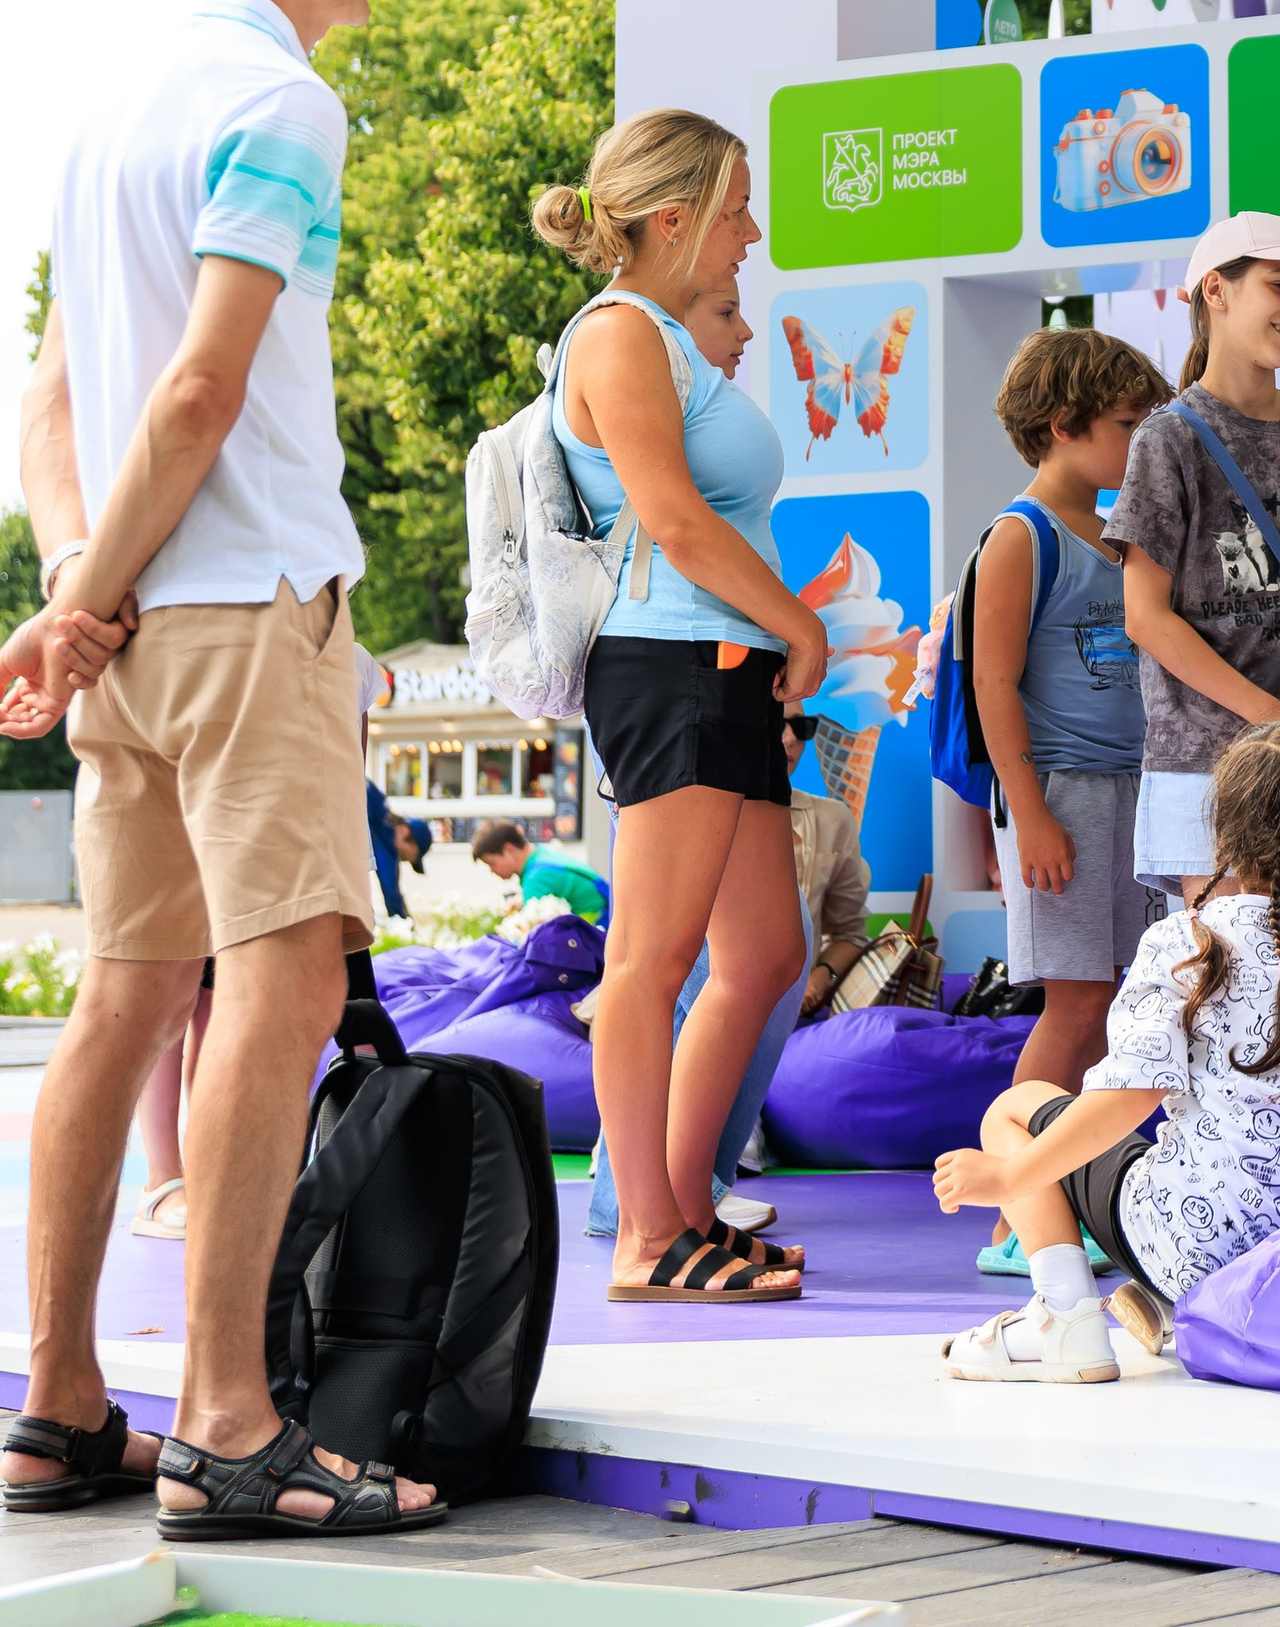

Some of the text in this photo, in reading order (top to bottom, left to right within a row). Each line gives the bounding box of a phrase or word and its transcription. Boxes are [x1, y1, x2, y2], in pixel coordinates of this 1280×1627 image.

[892, 128, 958, 150] ПРОЕКТ
[892, 151, 940, 170] МЭРА
[892, 168, 967, 190] МОСКВЫ
[1200, 599, 1250, 619] PLEASE
[1234, 613, 1264, 628] BAD
[1239, 1187, 1264, 1209] BEST
